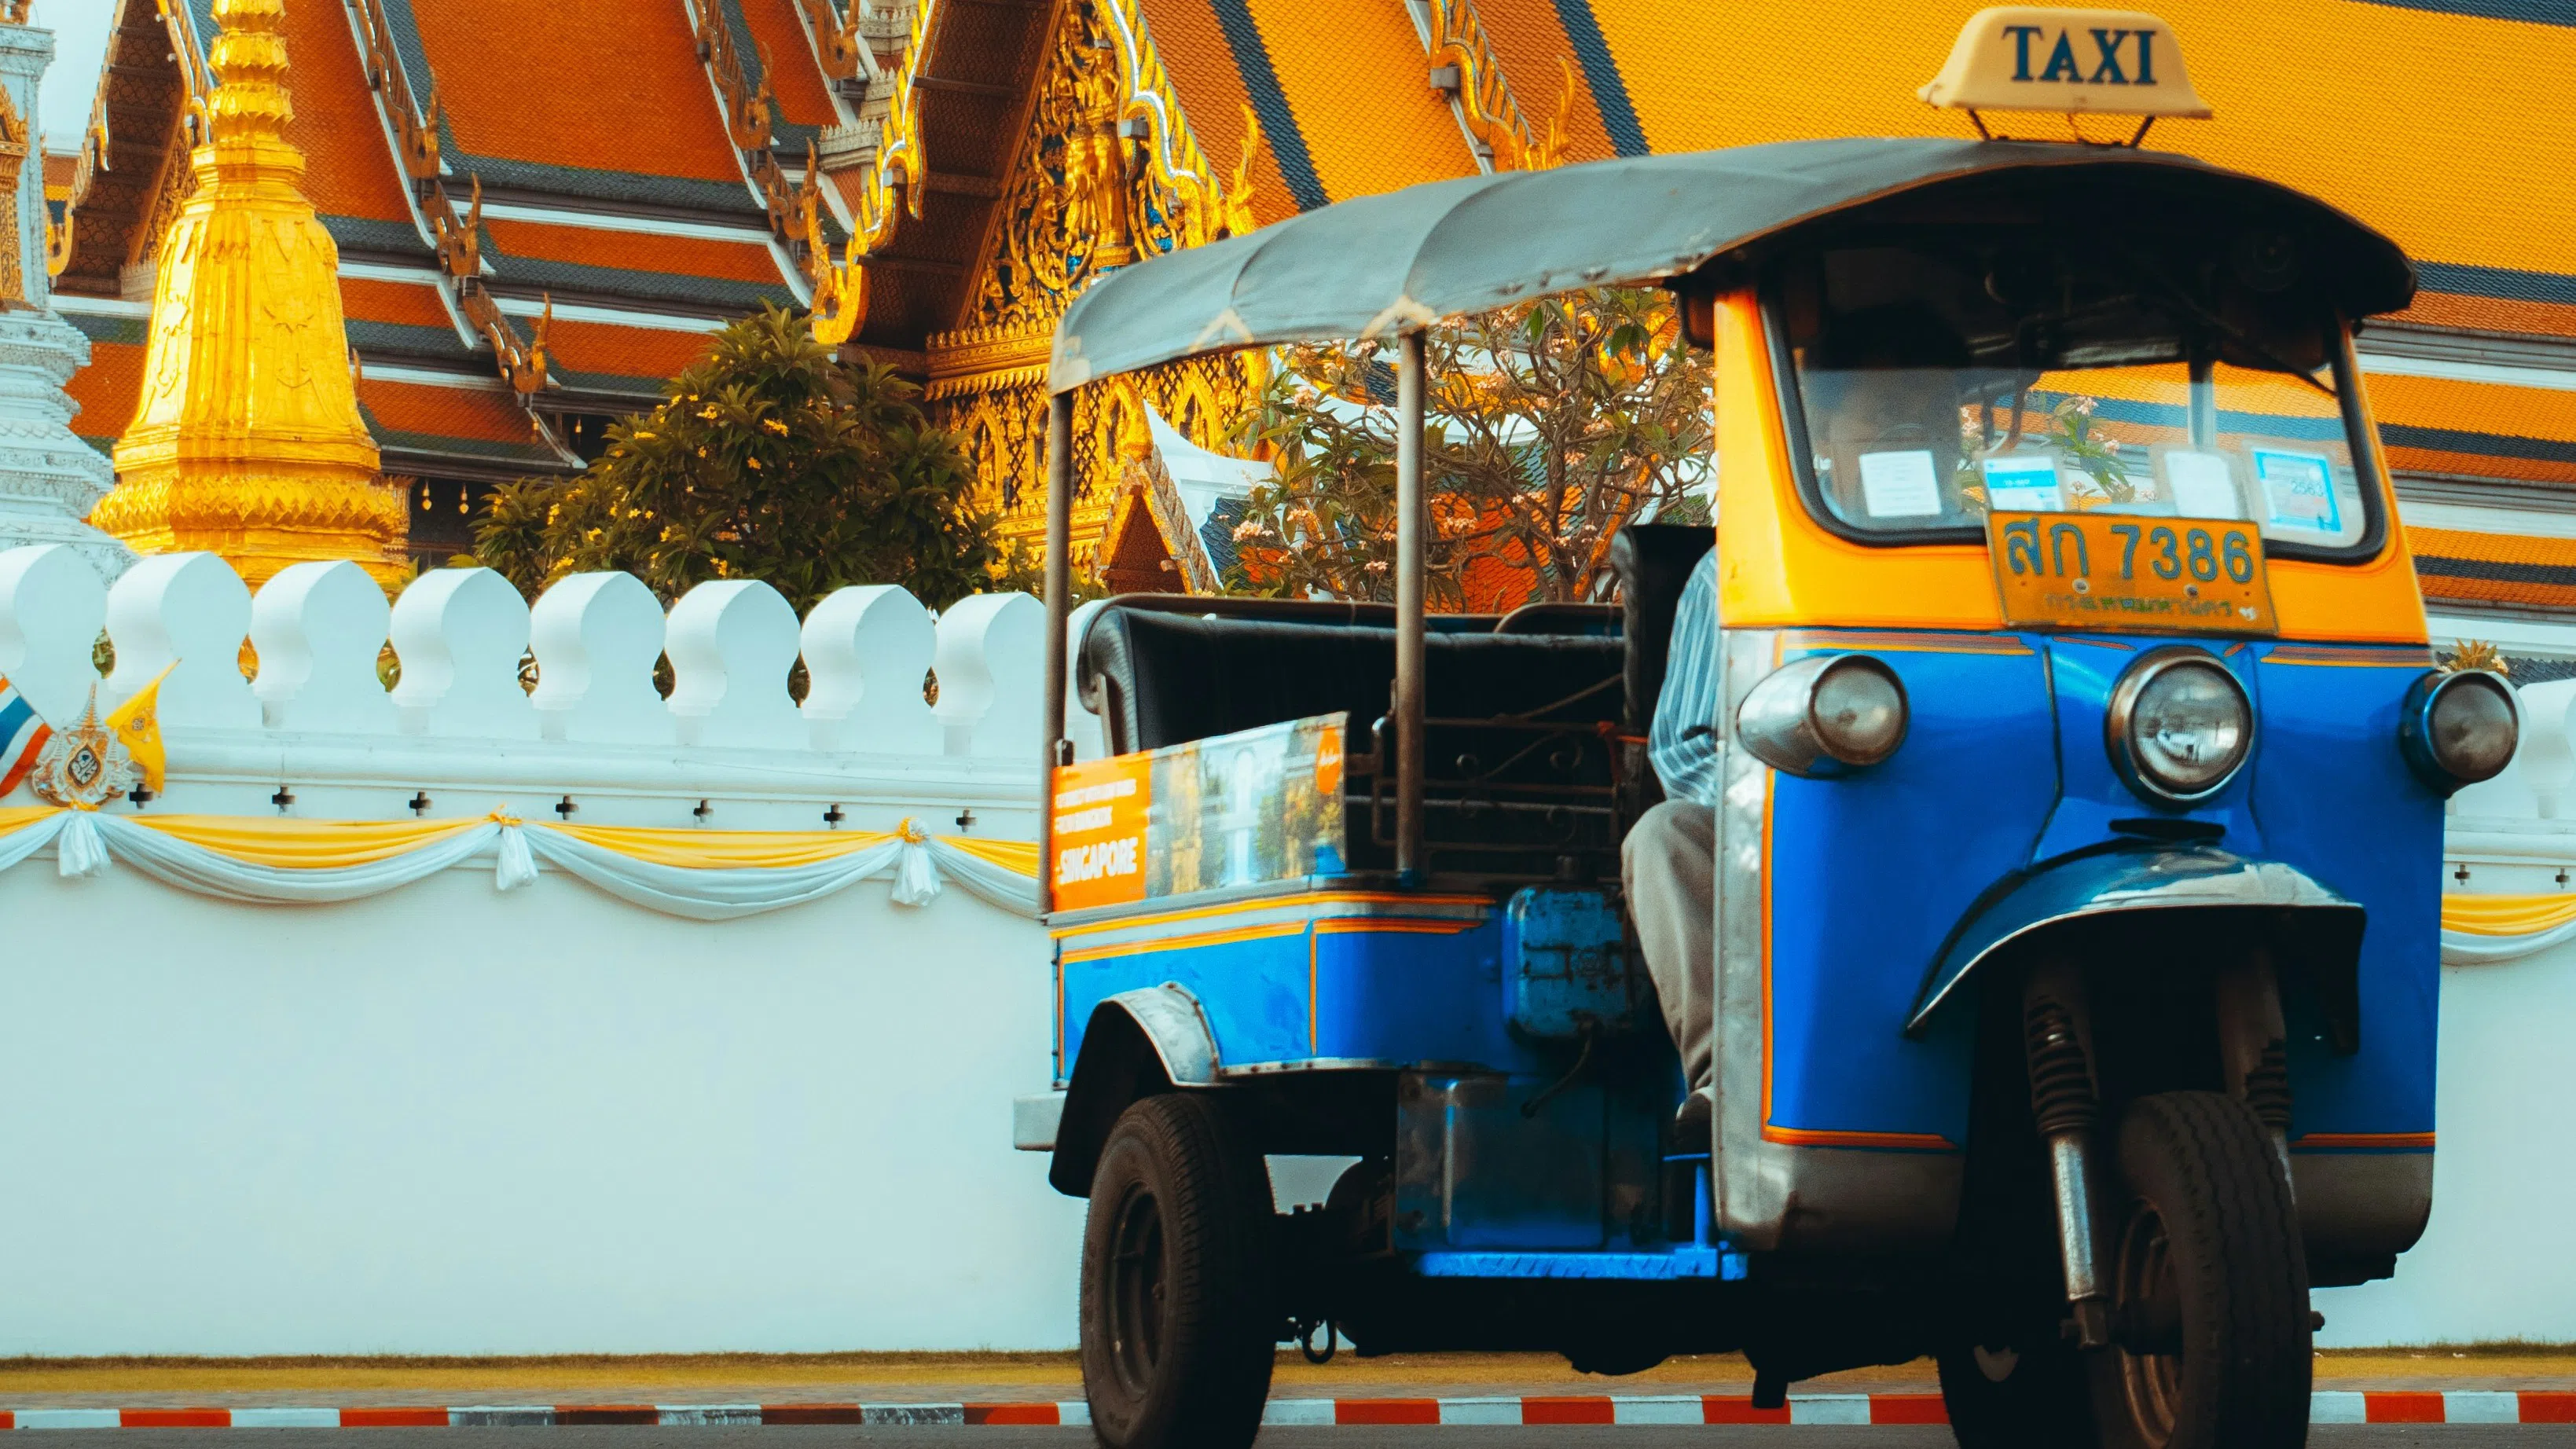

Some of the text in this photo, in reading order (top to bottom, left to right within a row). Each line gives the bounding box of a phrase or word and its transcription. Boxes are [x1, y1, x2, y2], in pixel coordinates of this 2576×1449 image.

[2001, 26, 2158, 86] TAXI
[2004, 517, 2253, 584] สก 7386
[1059, 836, 1139, 886] SINGAPORE
